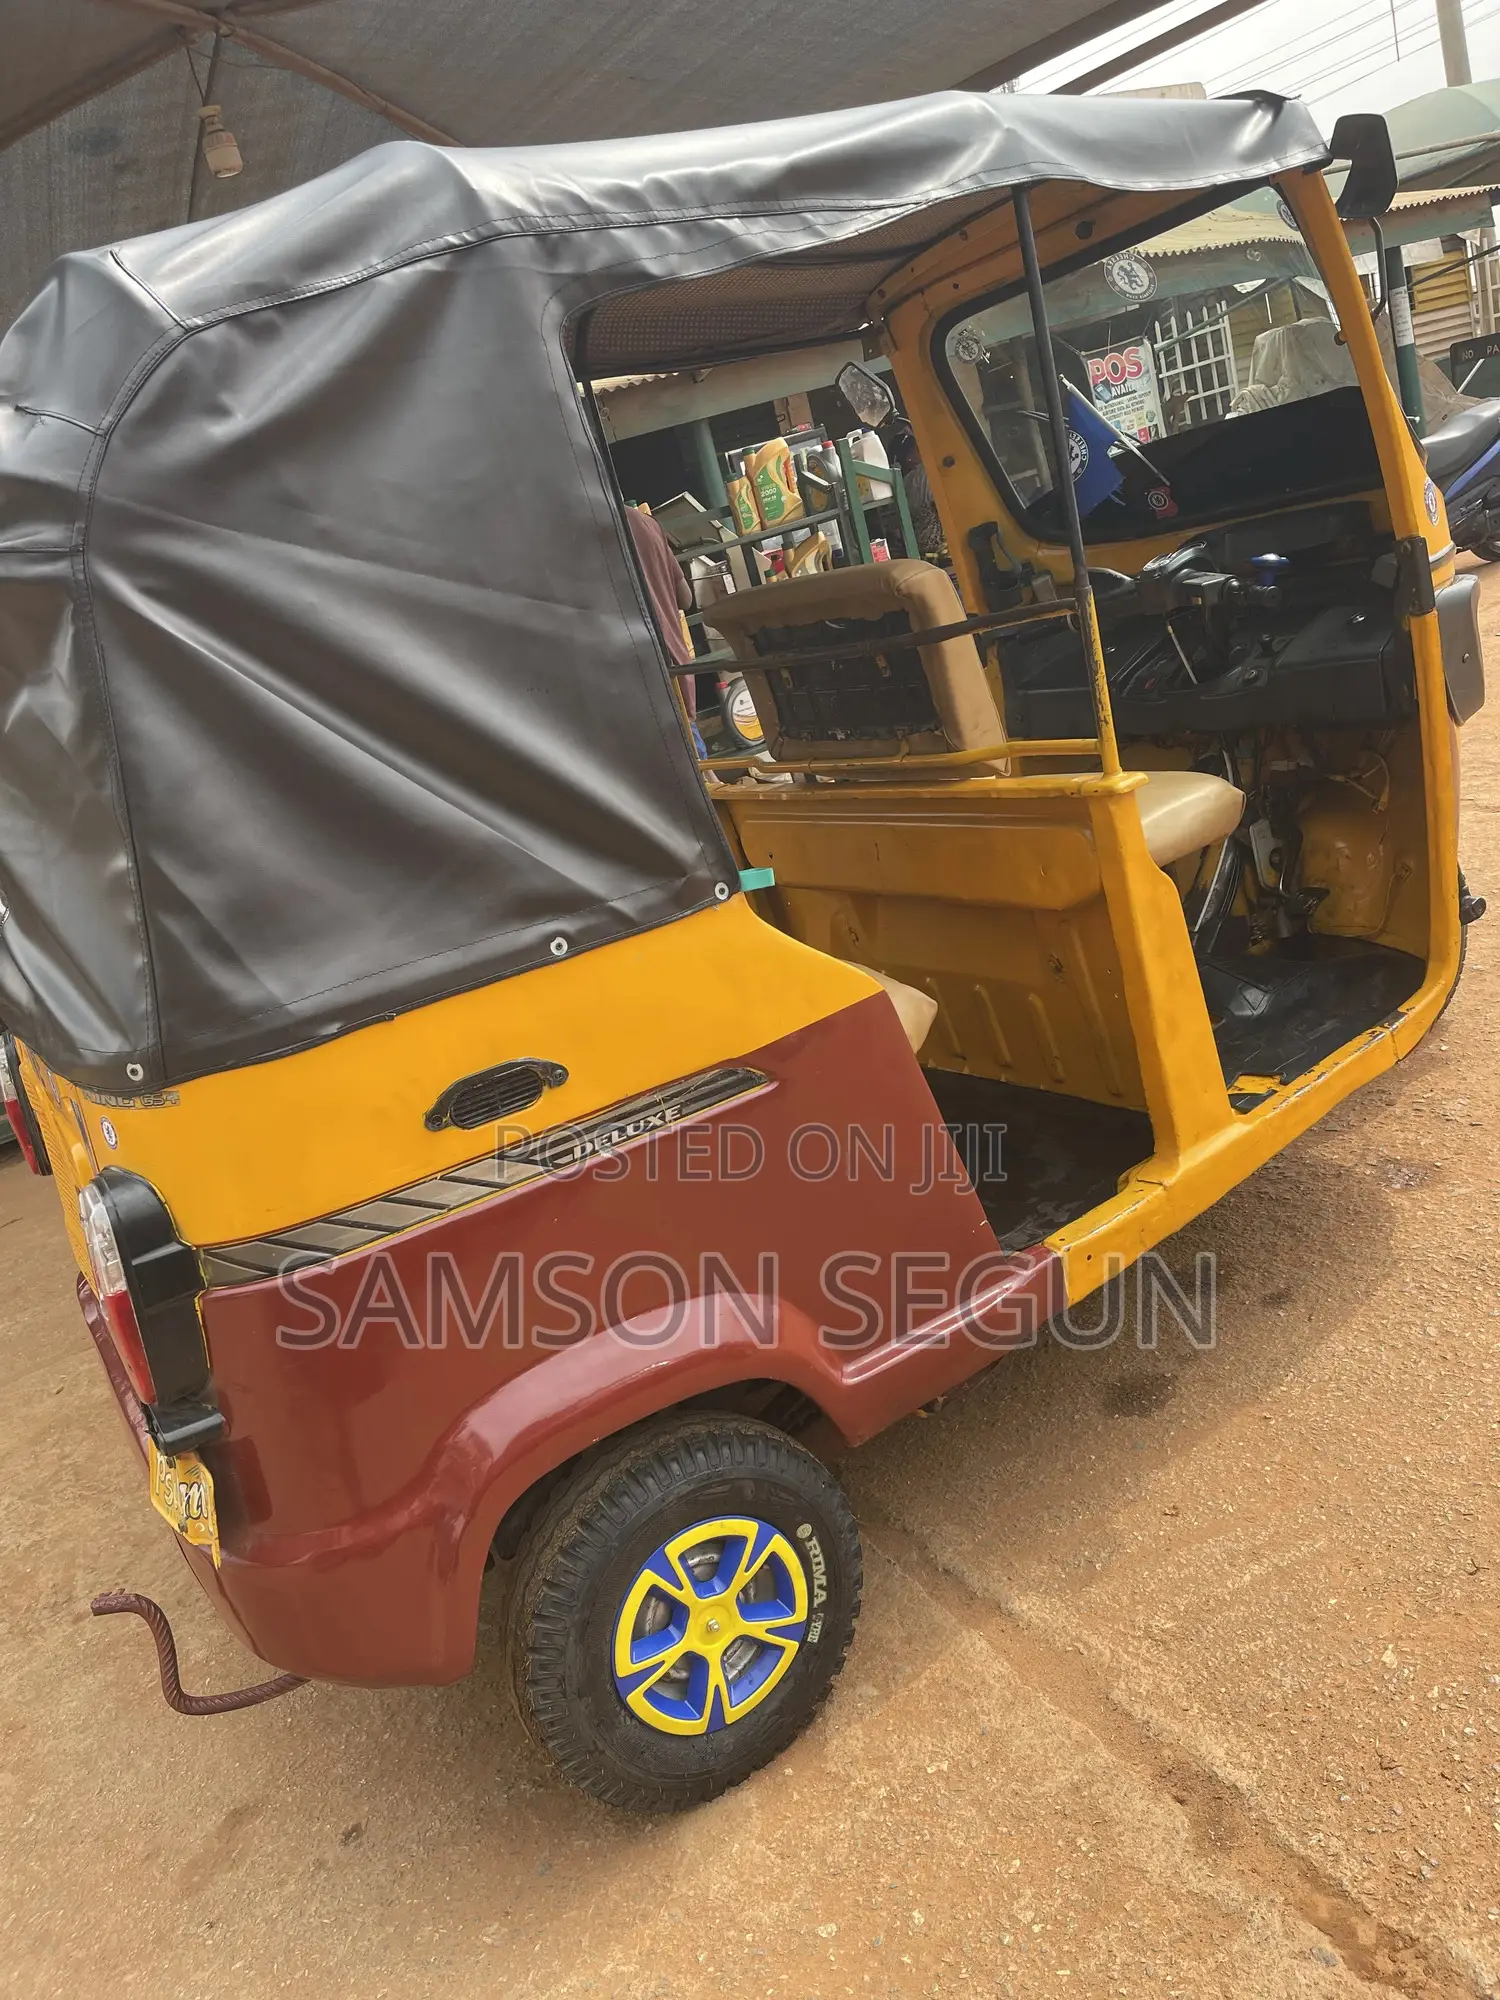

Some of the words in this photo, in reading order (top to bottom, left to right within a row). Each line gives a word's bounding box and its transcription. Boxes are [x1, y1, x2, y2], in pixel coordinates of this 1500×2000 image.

[1088, 347, 1143, 385] POS
[760, 487, 777, 497] 2000
[573, 1105, 682, 1160] DELUXE
[805, 1536, 828, 1608] RIMA
